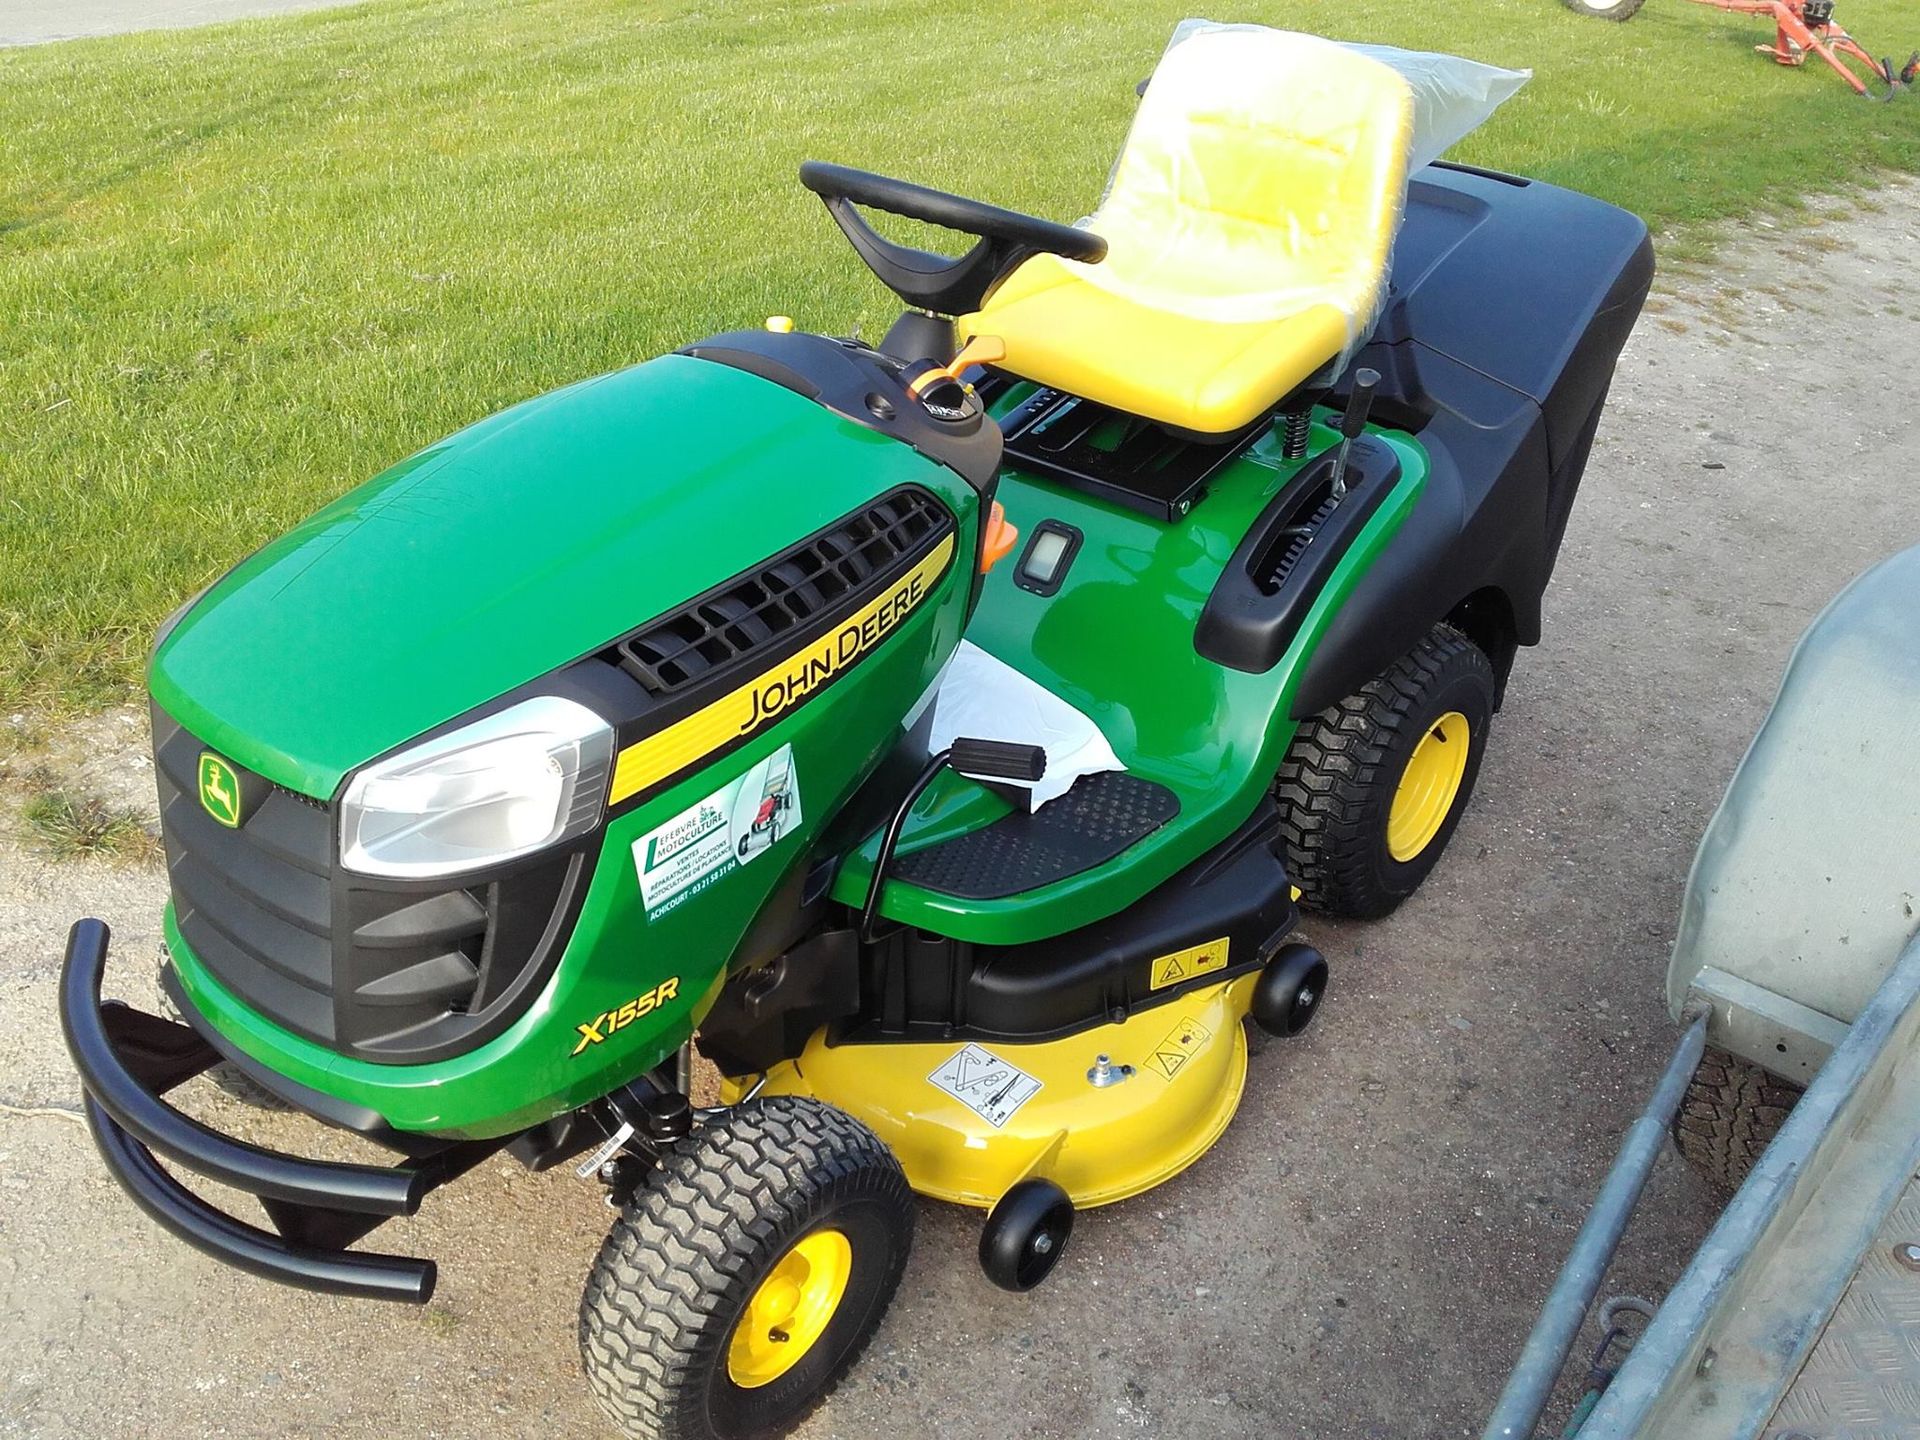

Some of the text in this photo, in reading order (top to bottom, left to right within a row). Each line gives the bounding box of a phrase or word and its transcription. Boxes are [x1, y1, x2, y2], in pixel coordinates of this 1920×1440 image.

[741, 572, 924, 731] JOHN DEERE
[657, 811, 723, 858] MOTOCULTURE
[676, 848, 700, 866] VENTES
[647, 845, 732, 902] MOTOCULTURE DE PLAISANCE
[650, 863, 691, 892] RÉPARATIONS
[695, 839, 727, 864] LOCATIONS
[649, 890, 689, 922] ACHICOURT
[692, 884, 701, 894] 03
[701, 877, 709, 888] 21
[710, 872, 719, 883] 58
[719, 867, 727, 877] 31
[570, 976, 680, 1057] X155R
